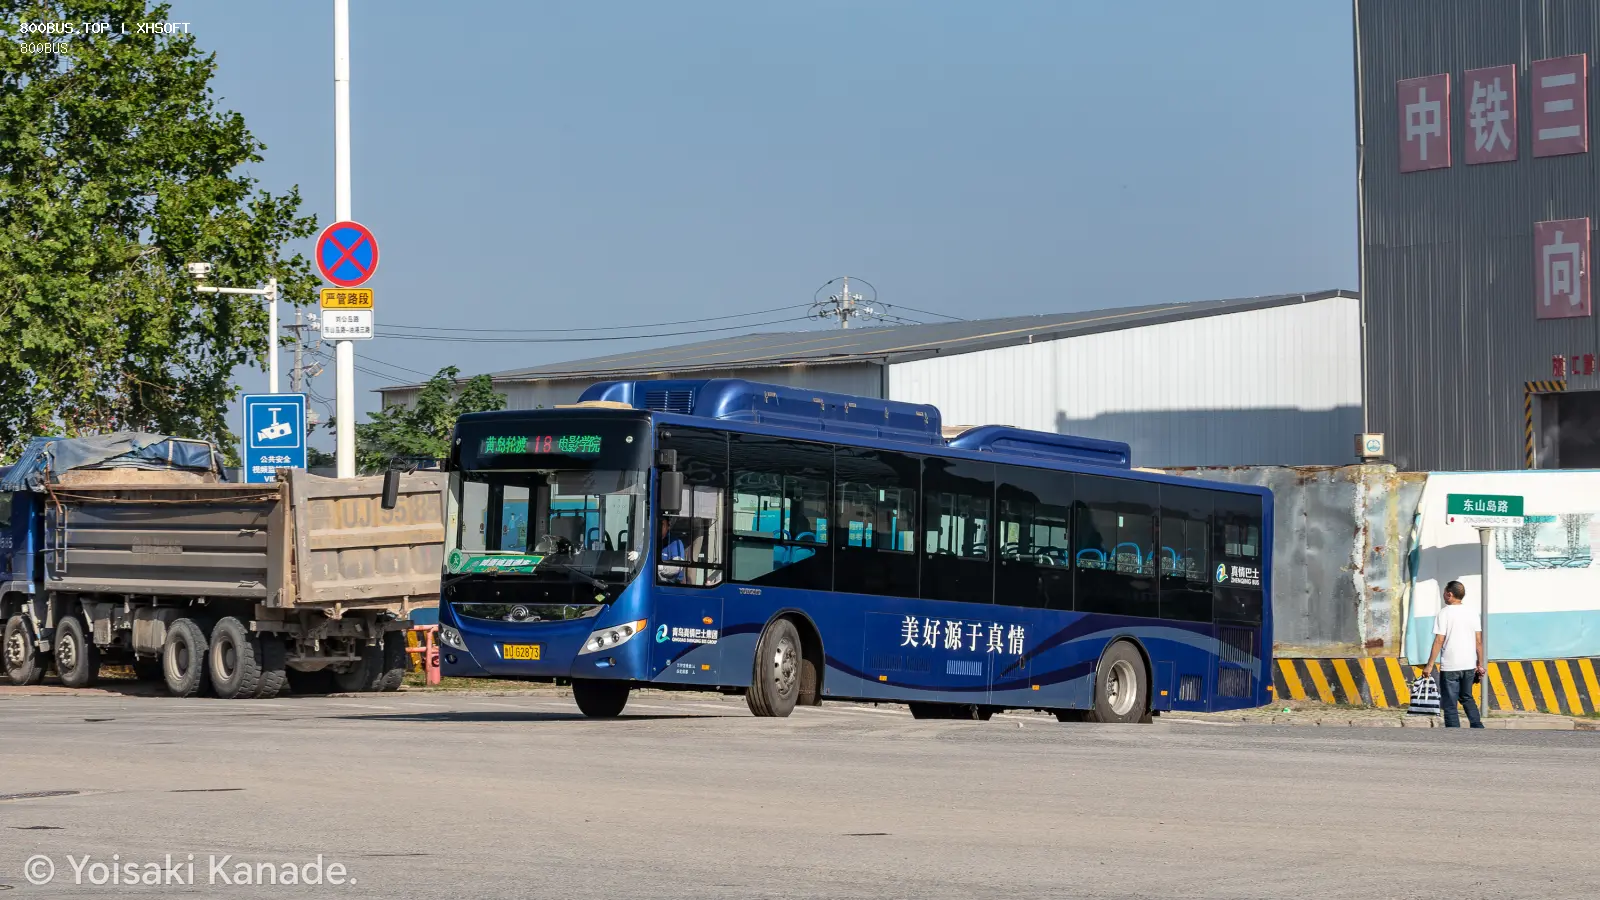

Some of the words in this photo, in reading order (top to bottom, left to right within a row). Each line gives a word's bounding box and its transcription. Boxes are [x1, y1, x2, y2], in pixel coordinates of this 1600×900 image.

[1543, 230, 1581, 306] 向
[325, 292, 369, 305] 严管路段
[484, 435, 528, 454] 黄岛轮渡
[534, 435, 553, 453] 18
[558, 435, 601, 453] 电影学院
[259, 455, 291, 464] 公共安全
[1463, 499, 1508, 513] 东山岛路
[1231, 565, 1260, 579] 真情巴士
[900, 615, 1025, 655] 美好源于真情
